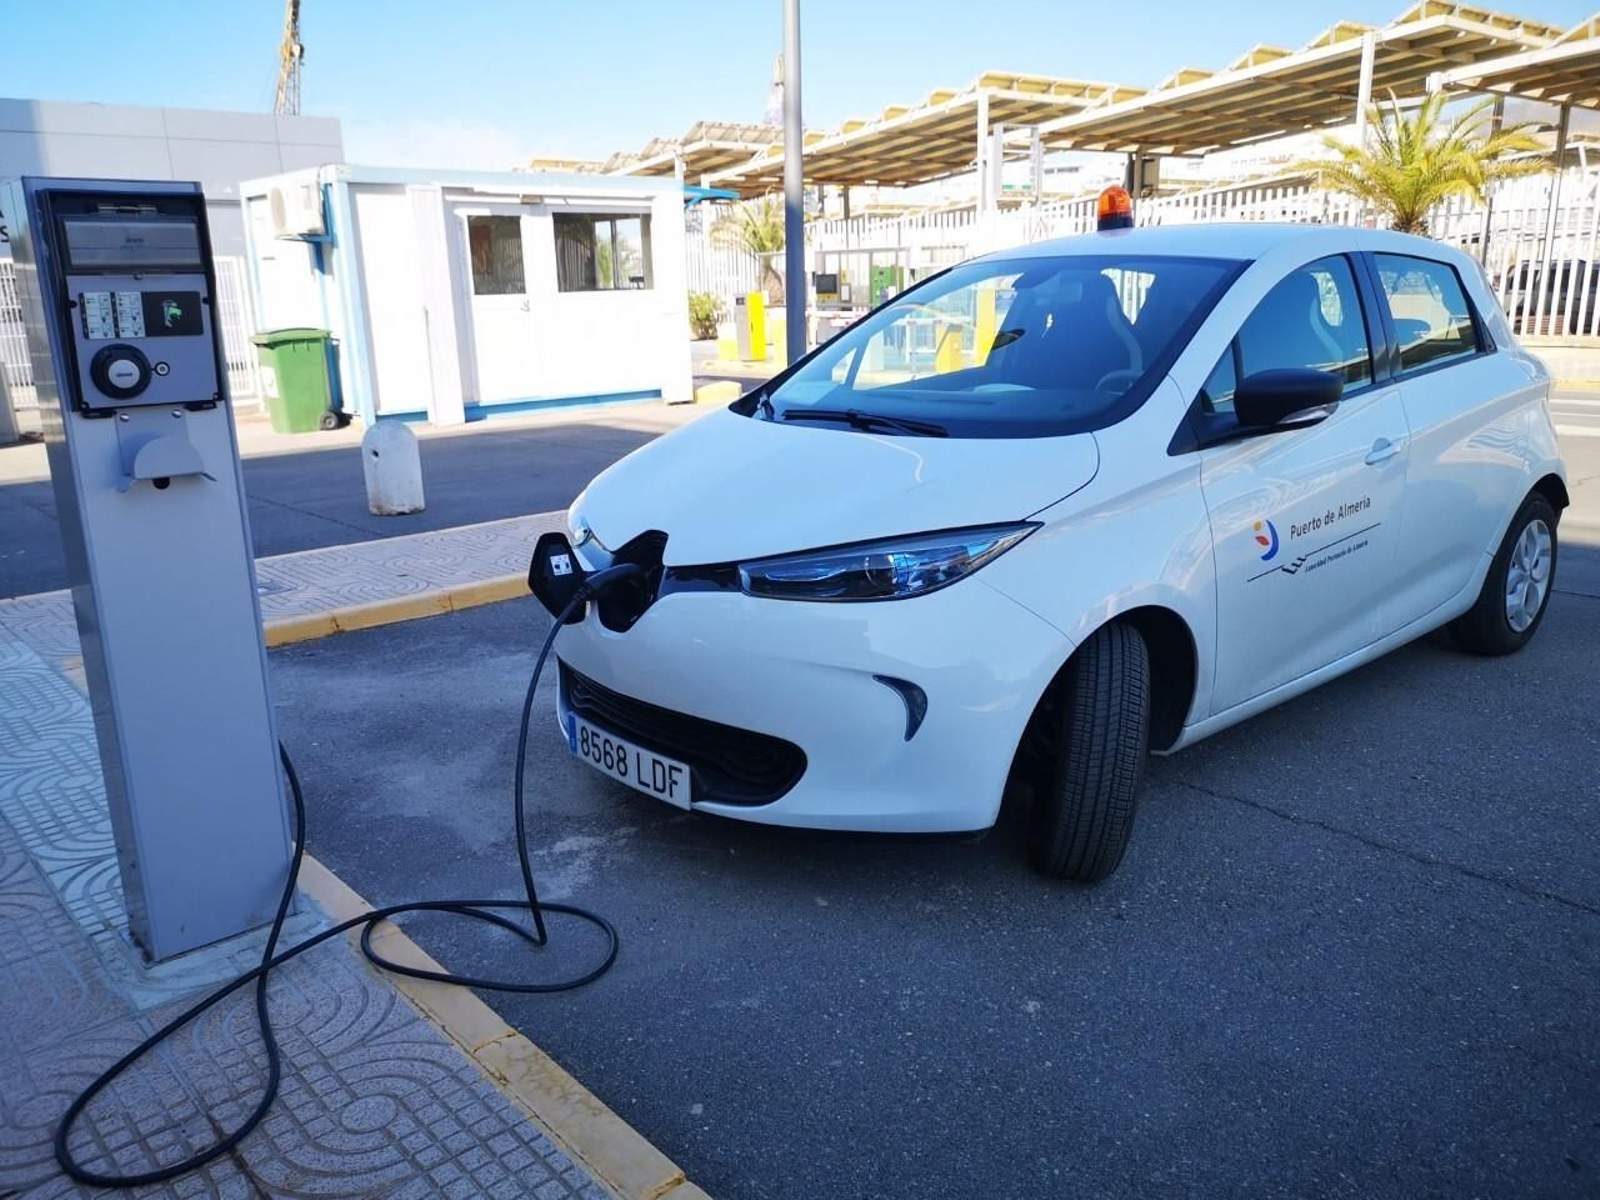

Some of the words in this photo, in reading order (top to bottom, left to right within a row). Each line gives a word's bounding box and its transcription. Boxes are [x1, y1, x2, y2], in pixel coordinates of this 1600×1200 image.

[1290, 517, 1322, 540] Puerto
[1324, 509, 1335, 526] de
[580, 726, 628, 777] 8568
[636, 751, 683, 798] LDF
